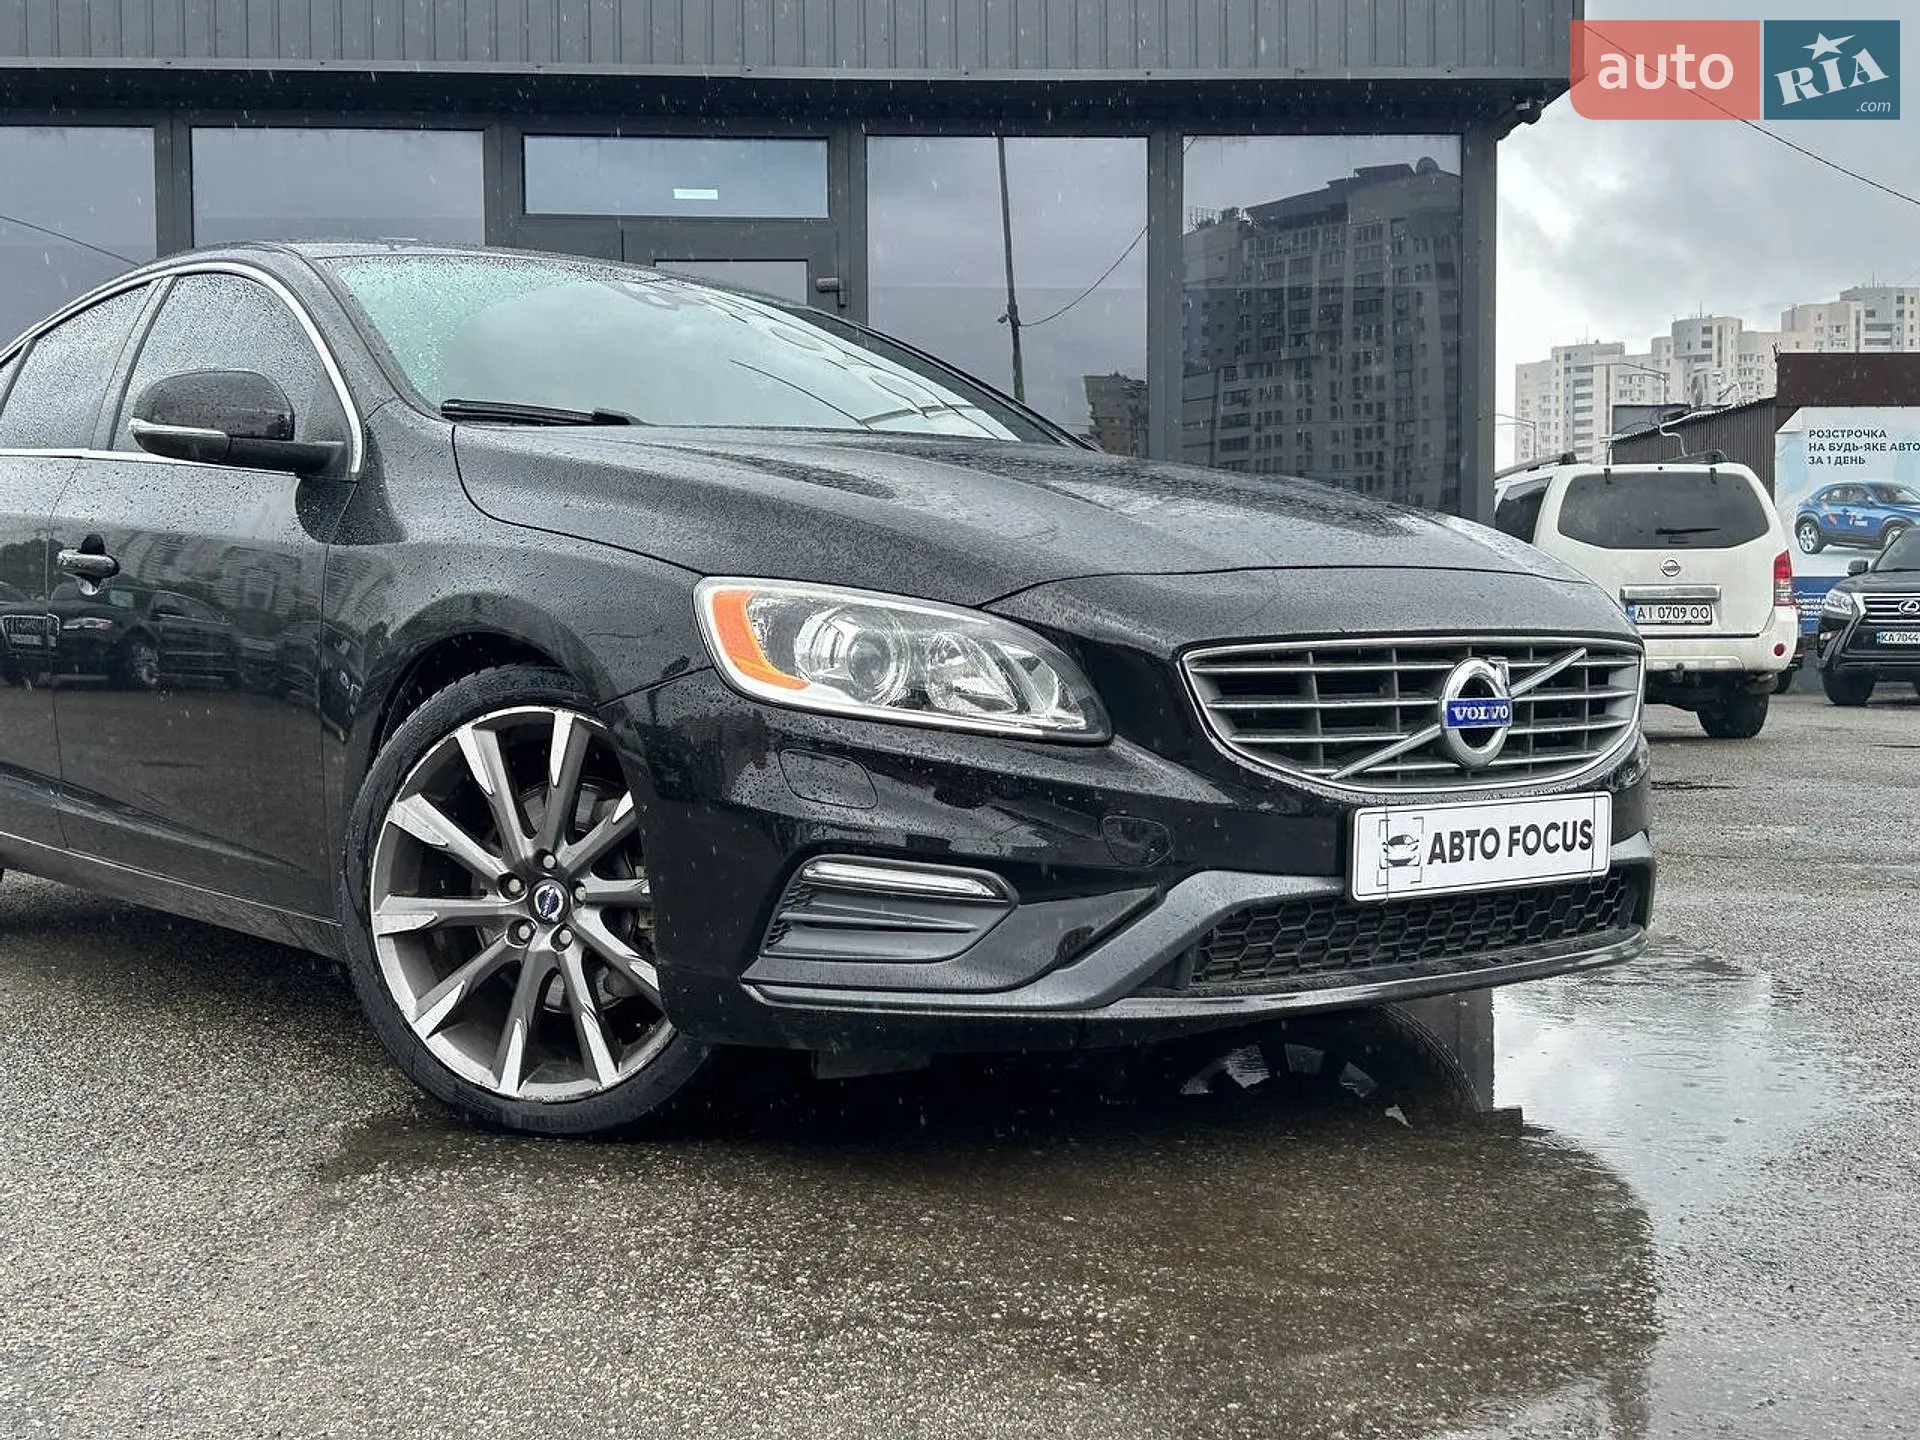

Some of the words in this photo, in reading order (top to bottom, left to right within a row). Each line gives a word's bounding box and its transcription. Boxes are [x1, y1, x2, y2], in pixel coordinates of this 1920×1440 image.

[1808, 429, 1887, 438] РОЗСТРОЧКА
[1808, 443, 1826, 452] НА
[1828, 443, 1887, 453] БУДЬ-ЯКЕ
[1889, 443, 1920, 452] АВТО
[1808, 456, 1824, 465] ЗА
[1826, 456, 1831, 465] 1
[1834, 456, 1866, 466] ДЕНЬ
[1636, 607, 1653, 619] AI
[1657, 607, 1687, 619] 0709
[1450, 705, 1509, 721] VOLVO
[1507, 819, 1593, 858] FOCUS
